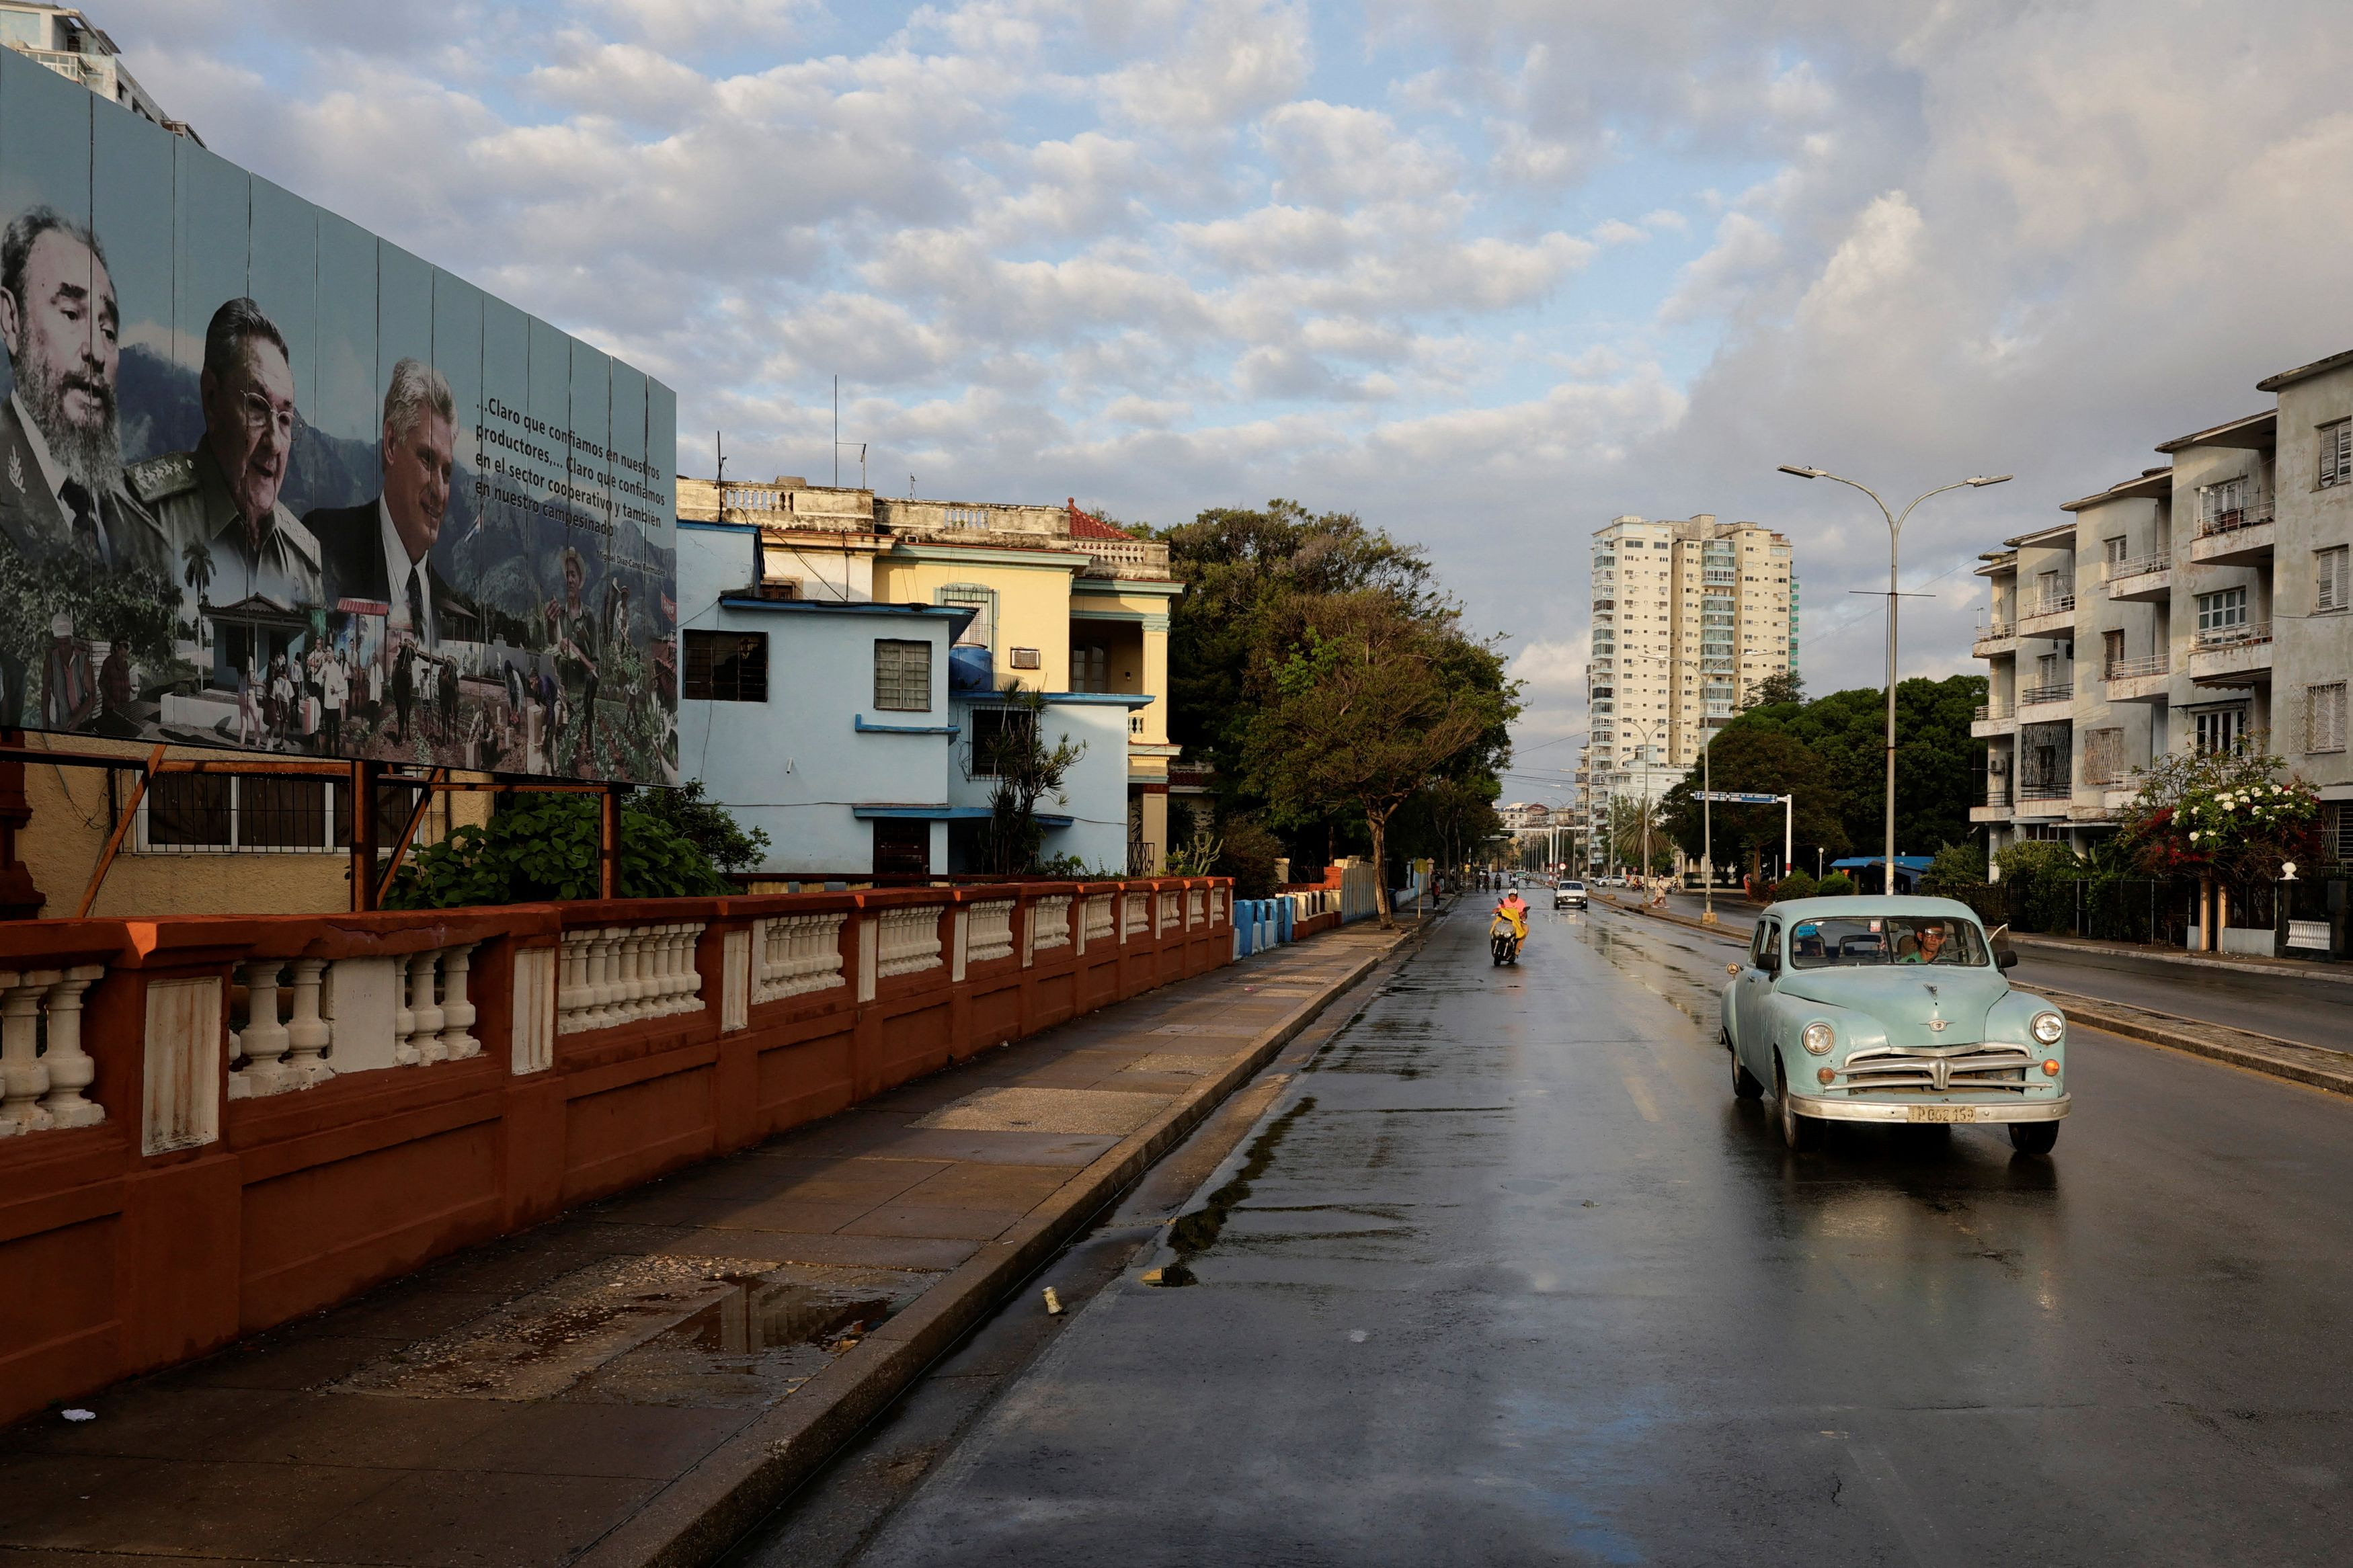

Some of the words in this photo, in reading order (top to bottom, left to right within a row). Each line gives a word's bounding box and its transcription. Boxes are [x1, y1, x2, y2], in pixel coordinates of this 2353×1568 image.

[524, 415, 546, 434] que
[549, 425, 604, 458] confiamos
[606, 449, 619, 464] en
[621, 454, 661, 481] nuestros
[475, 452, 491, 470] en
[494, 457, 506, 474] el
[509, 464, 545, 488] sector
[548, 479, 612, 511] cooperativo
[614, 502, 621, 518] y
[623, 502, 662, 528] también
[475, 481, 490, 497] en
[494, 487, 539, 513] nuestro
[542, 504, 614, 537] campesinado
[566, 456, 594, 481] Claro
[597, 471, 616, 488] que
[619, 479, 666, 506] confiamos
[596, 550, 616, 563] Miguel
